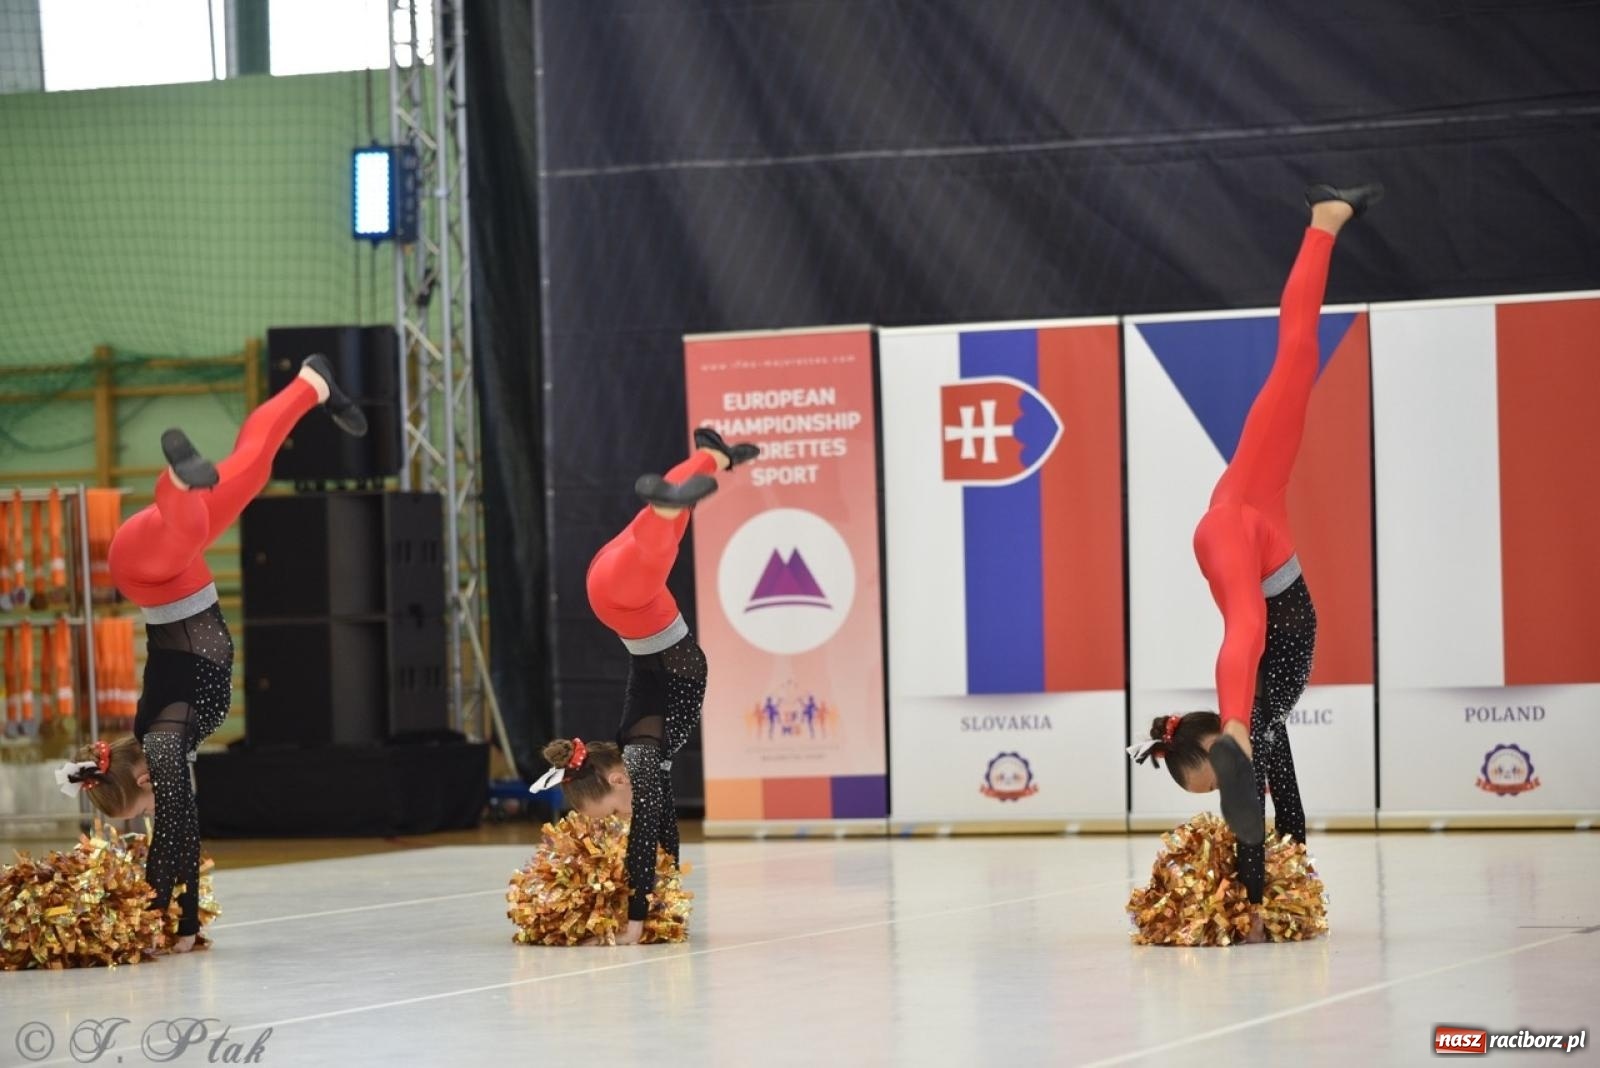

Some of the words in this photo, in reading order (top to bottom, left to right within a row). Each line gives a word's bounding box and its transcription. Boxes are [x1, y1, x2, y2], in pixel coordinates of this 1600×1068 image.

[723, 388, 836, 411] EUROPEAN
[732, 438, 847, 464] ORETTES
[751, 464, 819, 487] SPORT
[960, 714, 1052, 732] SLOVAKIA
[1289, 709, 1333, 725] BLIC
[1464, 706, 1546, 723] POLAND
